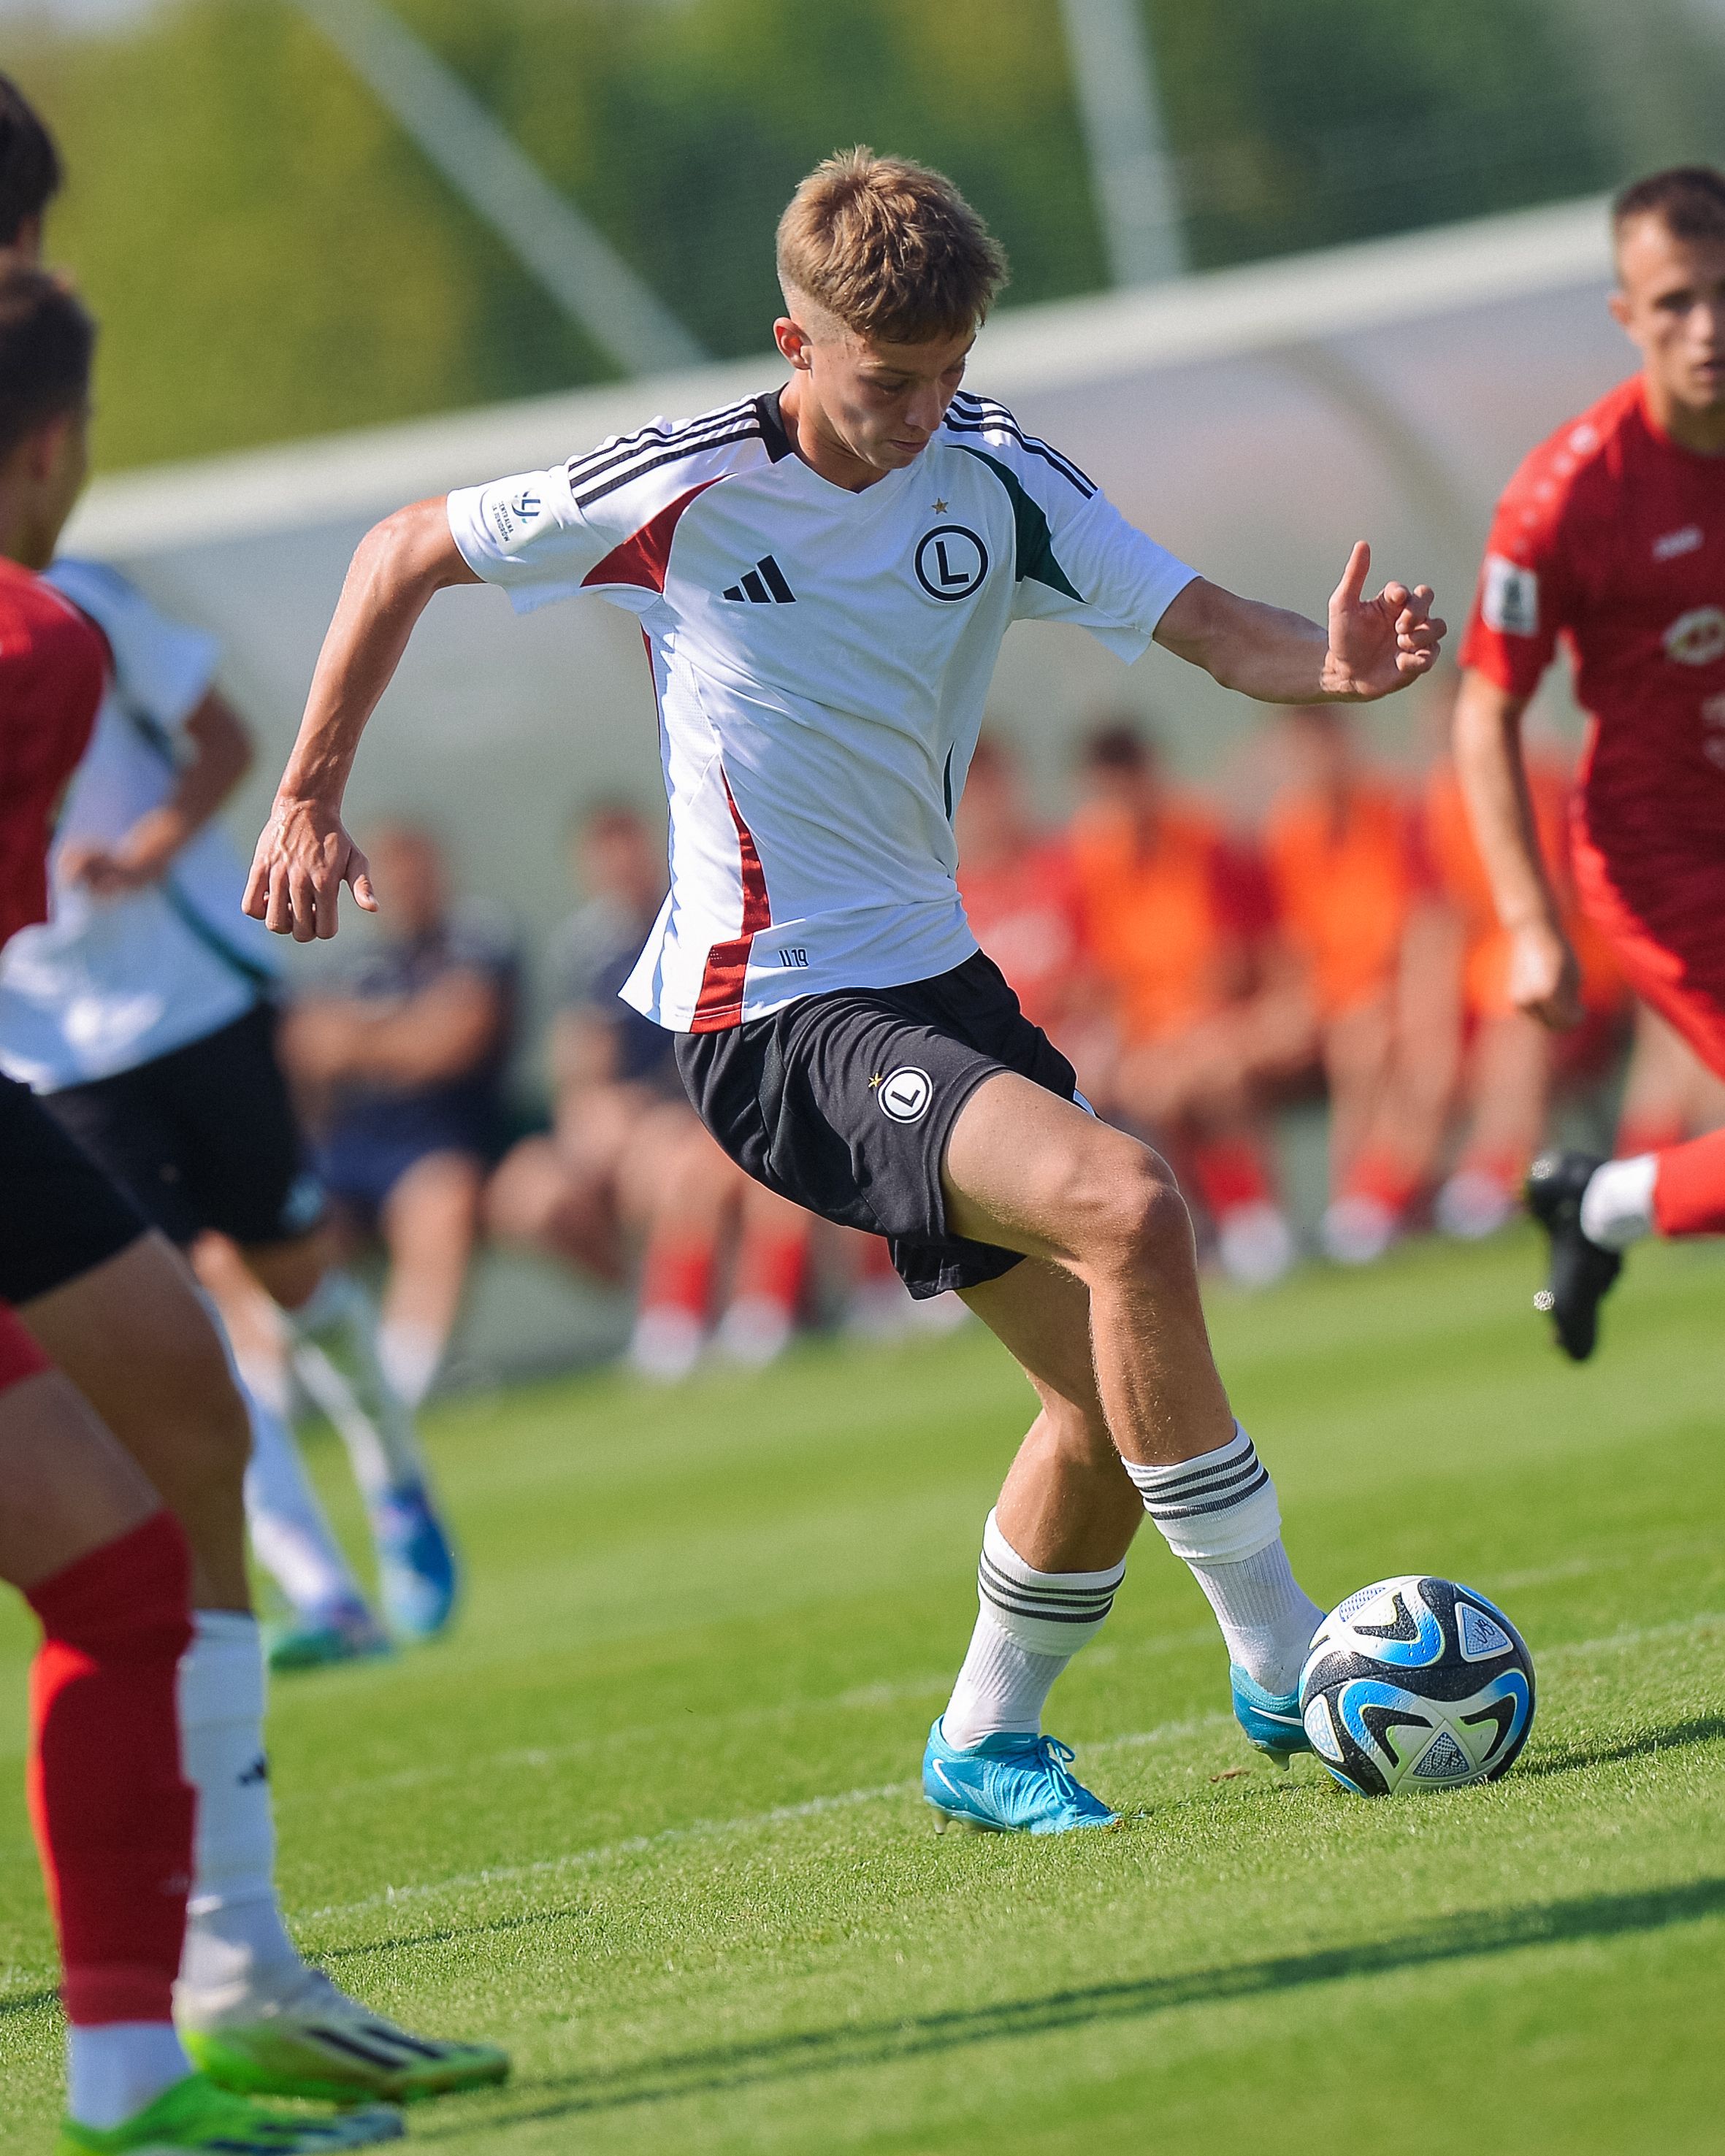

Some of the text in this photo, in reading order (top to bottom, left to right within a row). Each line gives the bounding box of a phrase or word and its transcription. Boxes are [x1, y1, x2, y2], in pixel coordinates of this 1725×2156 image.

[935, 540, 970, 586] L
[890, 1089, 921, 1108] L
[1358, 1754, 1386, 1789] OCEAU
